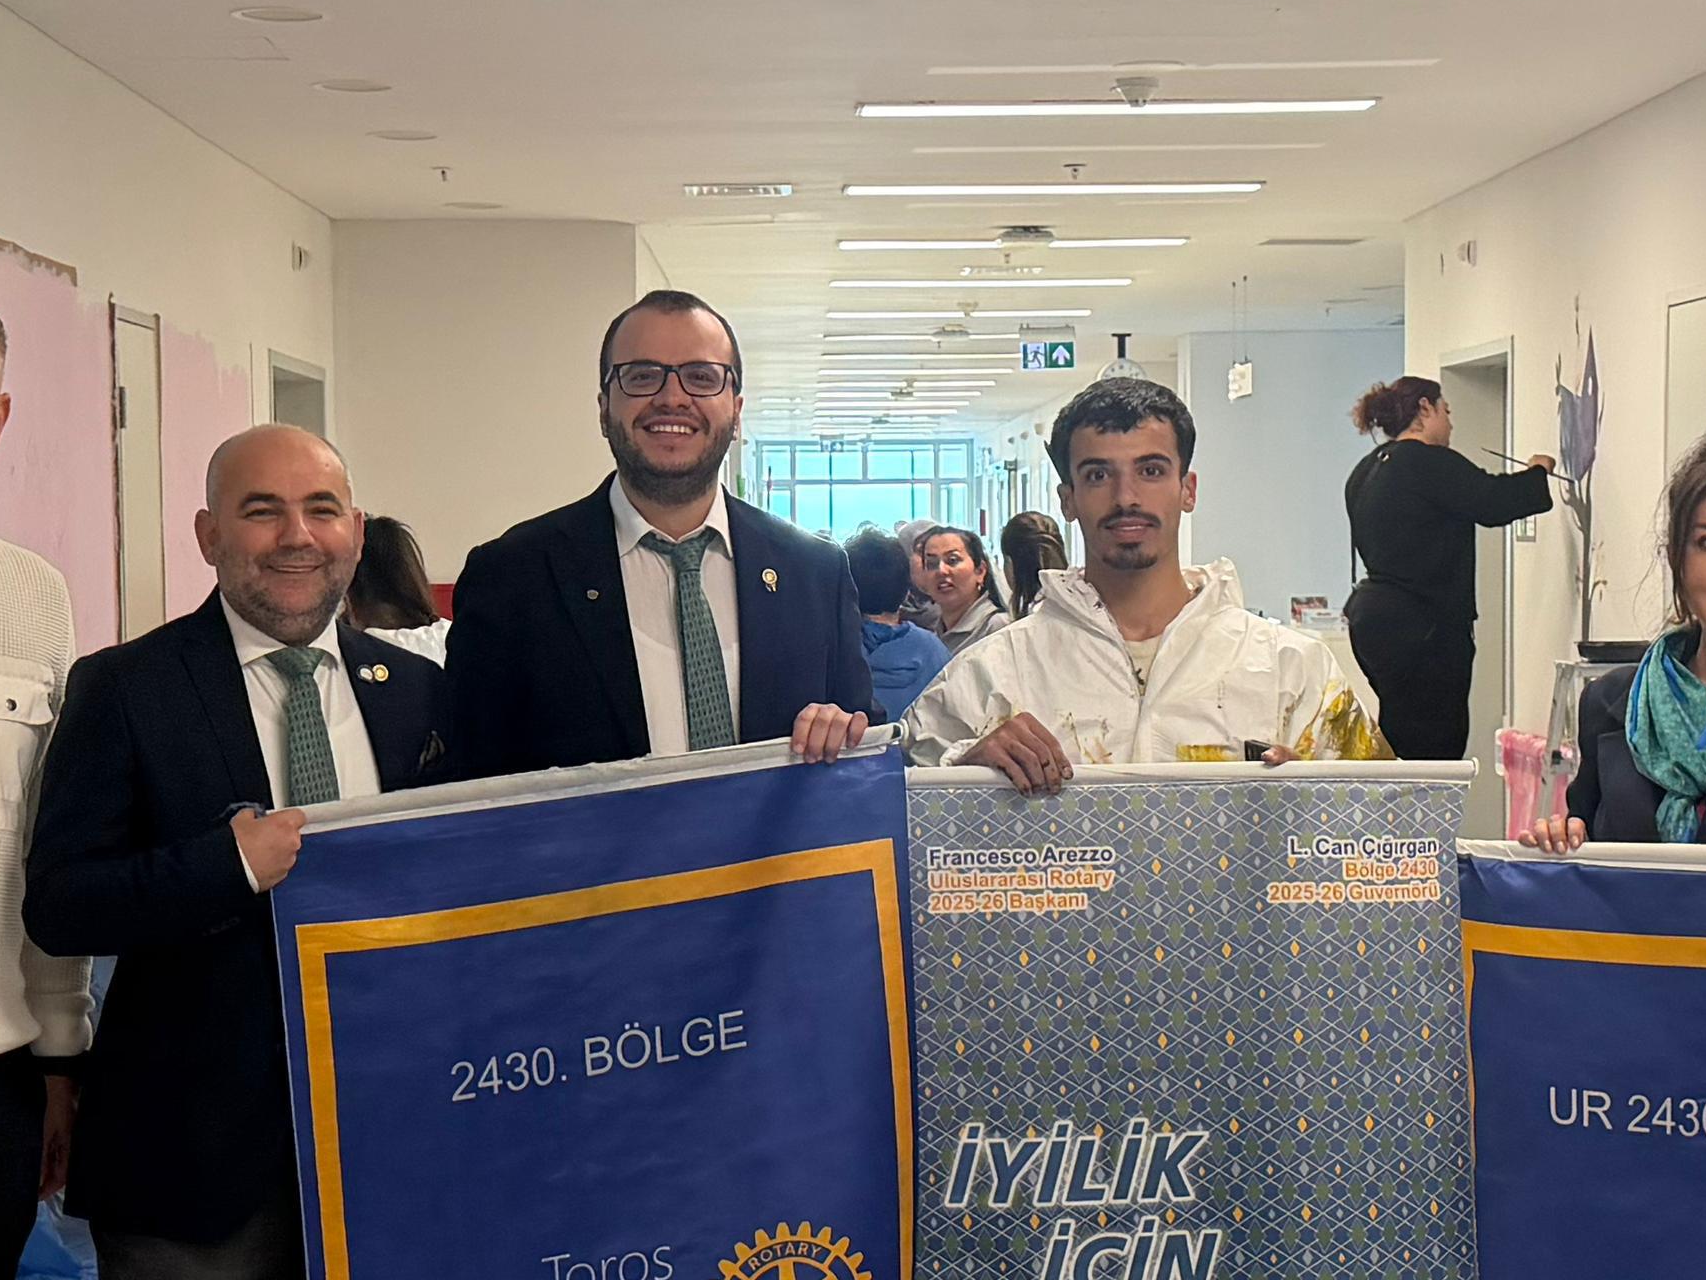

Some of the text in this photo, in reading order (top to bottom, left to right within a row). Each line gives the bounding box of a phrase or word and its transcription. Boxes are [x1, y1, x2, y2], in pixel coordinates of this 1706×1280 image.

[929, 847, 1113, 865] Francesco Arezzo
[1290, 836, 1437, 859] L. Can Çığırgan
[930, 870, 1113, 888] Uluslararası Rotary
[1345, 861, 1436, 880] Bölge 2430
[931, 894, 1085, 911] 2025-26 Başkanı
[1269, 885, 1343, 901] 2025-26
[451, 1009, 748, 1102] 2430. BÖLGE
[1548, 1086, 1612, 1130] UR
[945, 1119, 1209, 1207] İYİLİK
[748, 1242, 821, 1271] ROTARY
